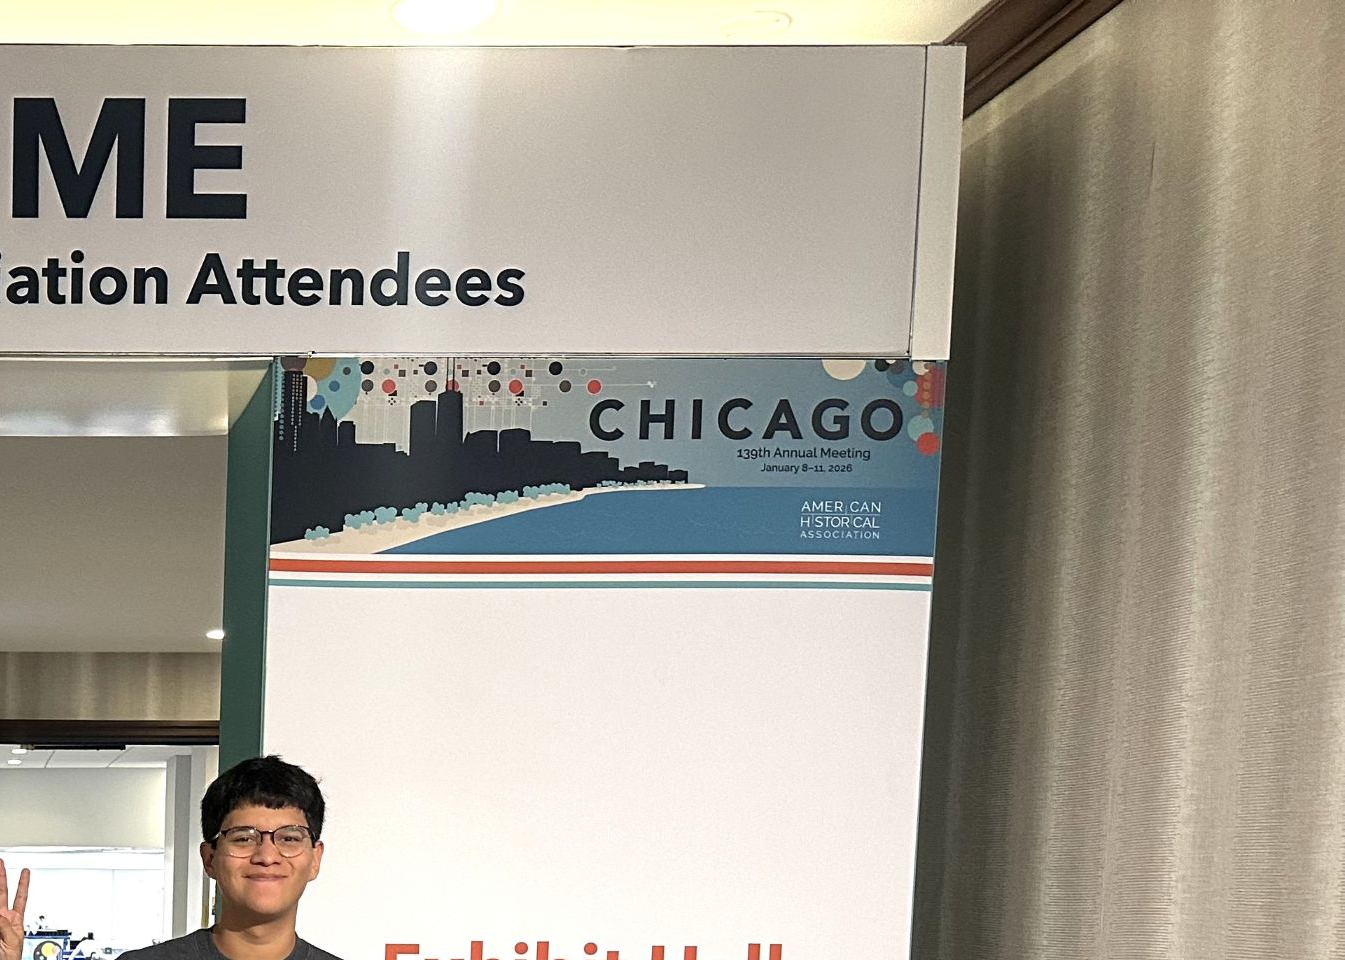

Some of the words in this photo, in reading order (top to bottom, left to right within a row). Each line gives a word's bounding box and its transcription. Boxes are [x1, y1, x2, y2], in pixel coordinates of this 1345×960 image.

[186, 252, 525, 306] Attendees
[589, 399, 904, 441] CHICAGO
[737, 447, 770, 459] 139th
[773, 448, 817, 458] Annual
[821, 448, 870, 461] Meeting
[761, 463, 799, 474] January
[828, 464, 852, 472] 2026
[800, 530, 881, 540] ASSOCIATION
